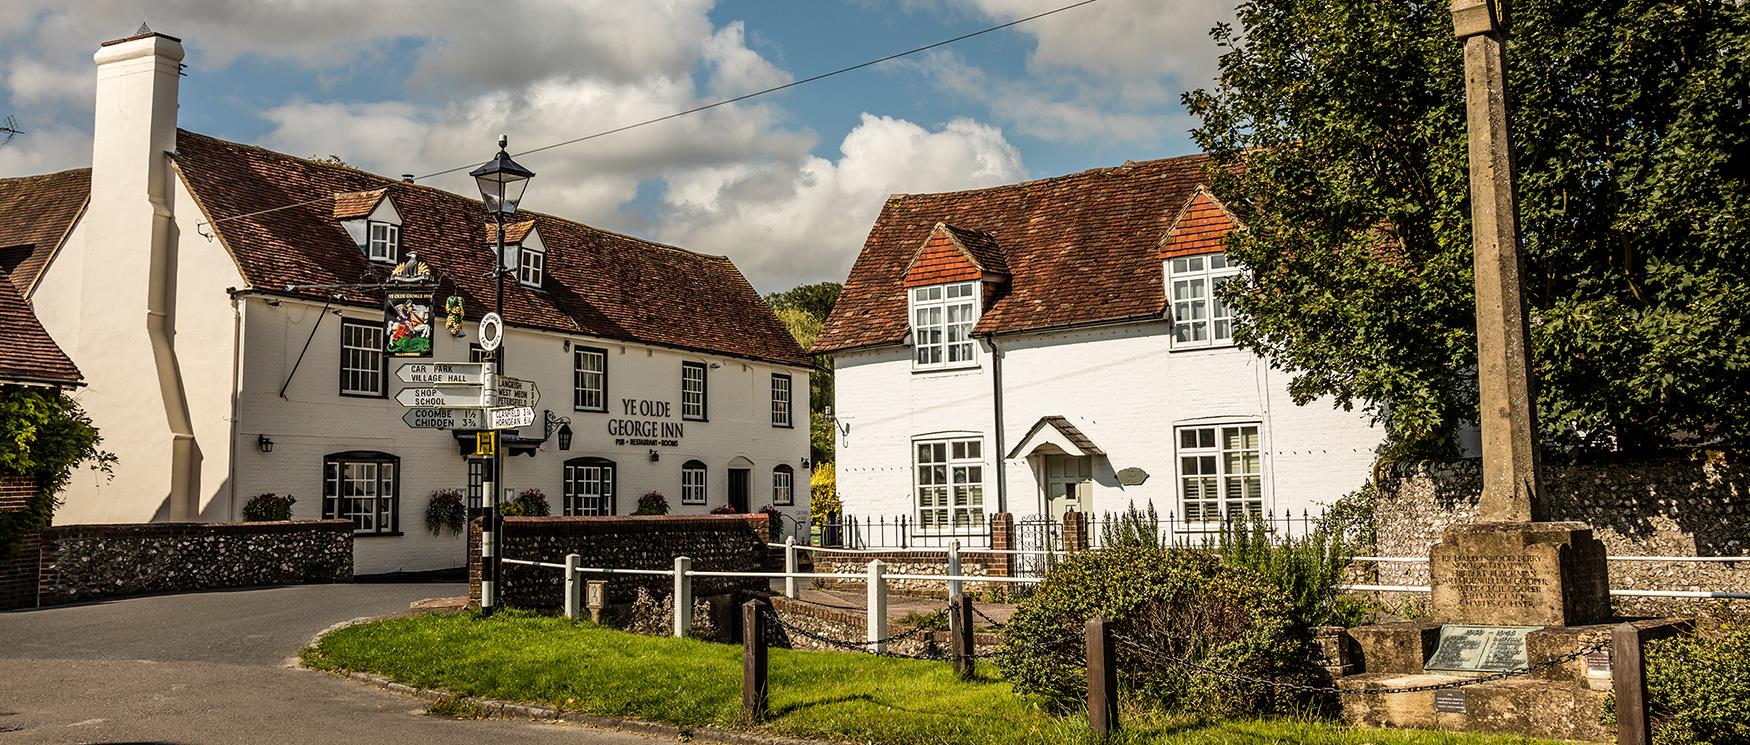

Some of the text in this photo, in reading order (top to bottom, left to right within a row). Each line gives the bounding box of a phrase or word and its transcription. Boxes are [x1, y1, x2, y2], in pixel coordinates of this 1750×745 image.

[410, 365, 453, 373] CAR PARK
[410, 374, 467, 382] VILLAGE HALL
[498, 388, 511, 396] WEST
[514, 390, 528, 398] MEON
[498, 396, 528, 407] PETERSFIELD
[622, 398, 671, 418] YE OLDE
[415, 410, 452, 418] COOMBE
[415, 419, 454, 427] CHIDDEN
[495, 417, 520, 427] HORNDEAN
[608, 418, 684, 438] GEORGE INN
[480, 434, 493, 452] H
[629, 438, 658, 446] RESTAURANT
[661, 439, 679, 447] ROOMS
